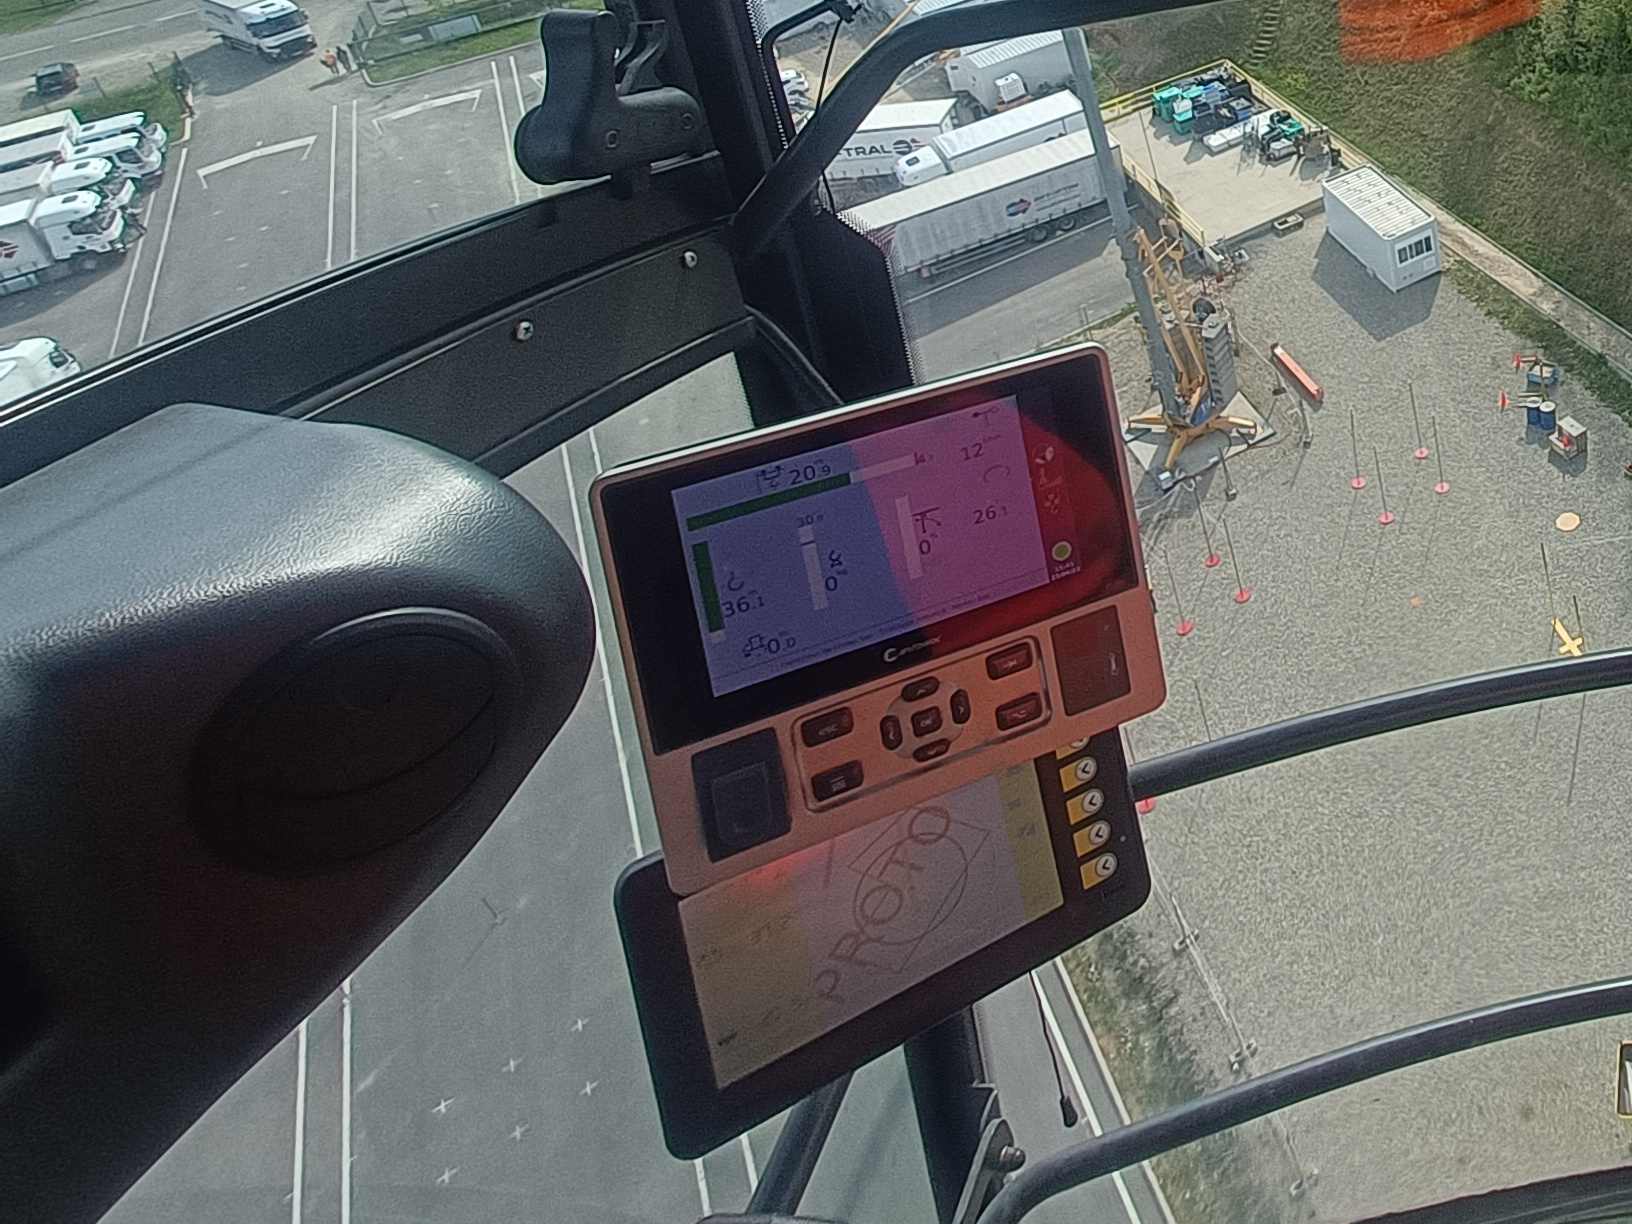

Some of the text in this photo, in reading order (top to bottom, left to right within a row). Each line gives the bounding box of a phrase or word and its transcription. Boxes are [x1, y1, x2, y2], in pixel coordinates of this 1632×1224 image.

[837, 144, 892, 158] TRAL
[960, 443, 985, 461] 12
[814, 804, 952, 1003] PROTO
